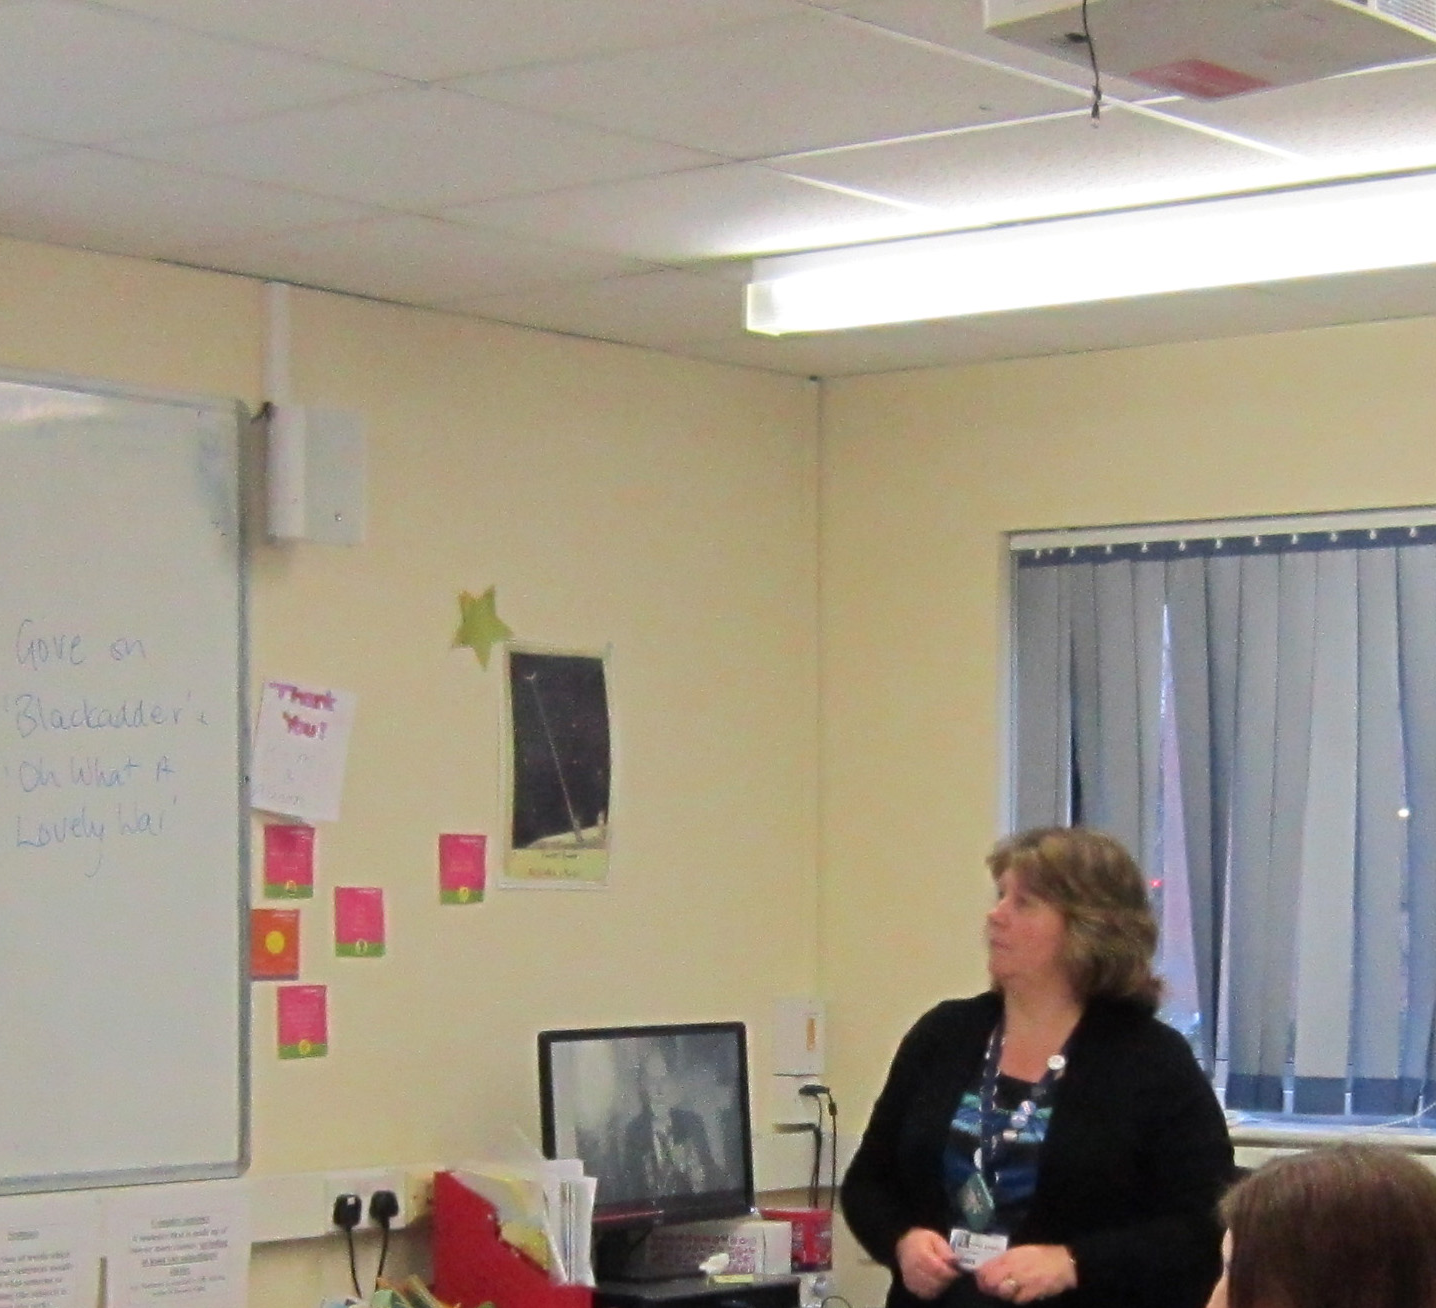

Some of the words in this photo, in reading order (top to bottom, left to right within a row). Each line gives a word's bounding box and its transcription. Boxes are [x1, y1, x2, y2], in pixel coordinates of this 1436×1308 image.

[17, 618, 86, 671] Gove
[110, 639, 146, 661] on
[269, 682, 338, 711] Thank
[283, 711, 327, 740] You!
[71, 756, 139, 787] What
[17, 805, 105, 878] Lovely
